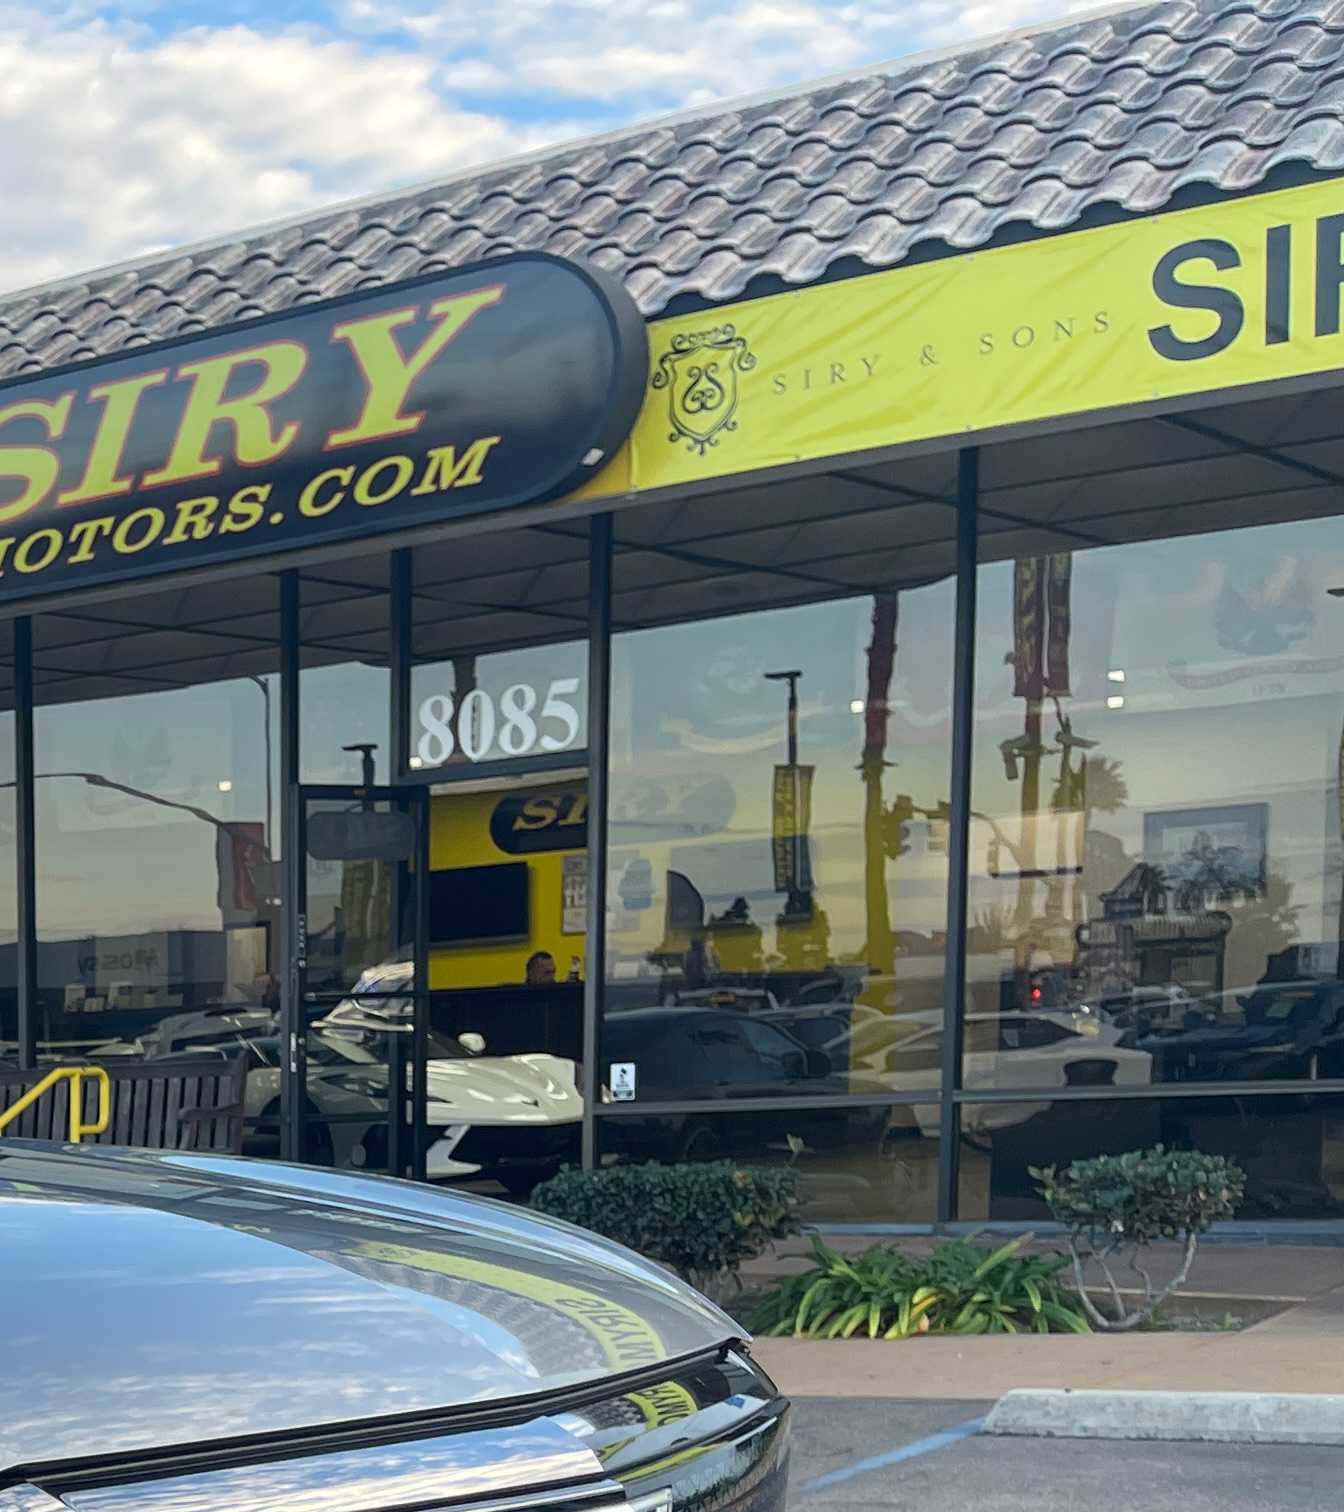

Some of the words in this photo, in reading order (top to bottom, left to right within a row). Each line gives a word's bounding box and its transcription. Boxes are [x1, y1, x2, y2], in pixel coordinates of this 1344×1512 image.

[772, 353, 881, 396] SIRY
[919, 344, 939, 367] &
[979, 310, 1110, 355] SONS
[418, 678, 580, 765] 8085
